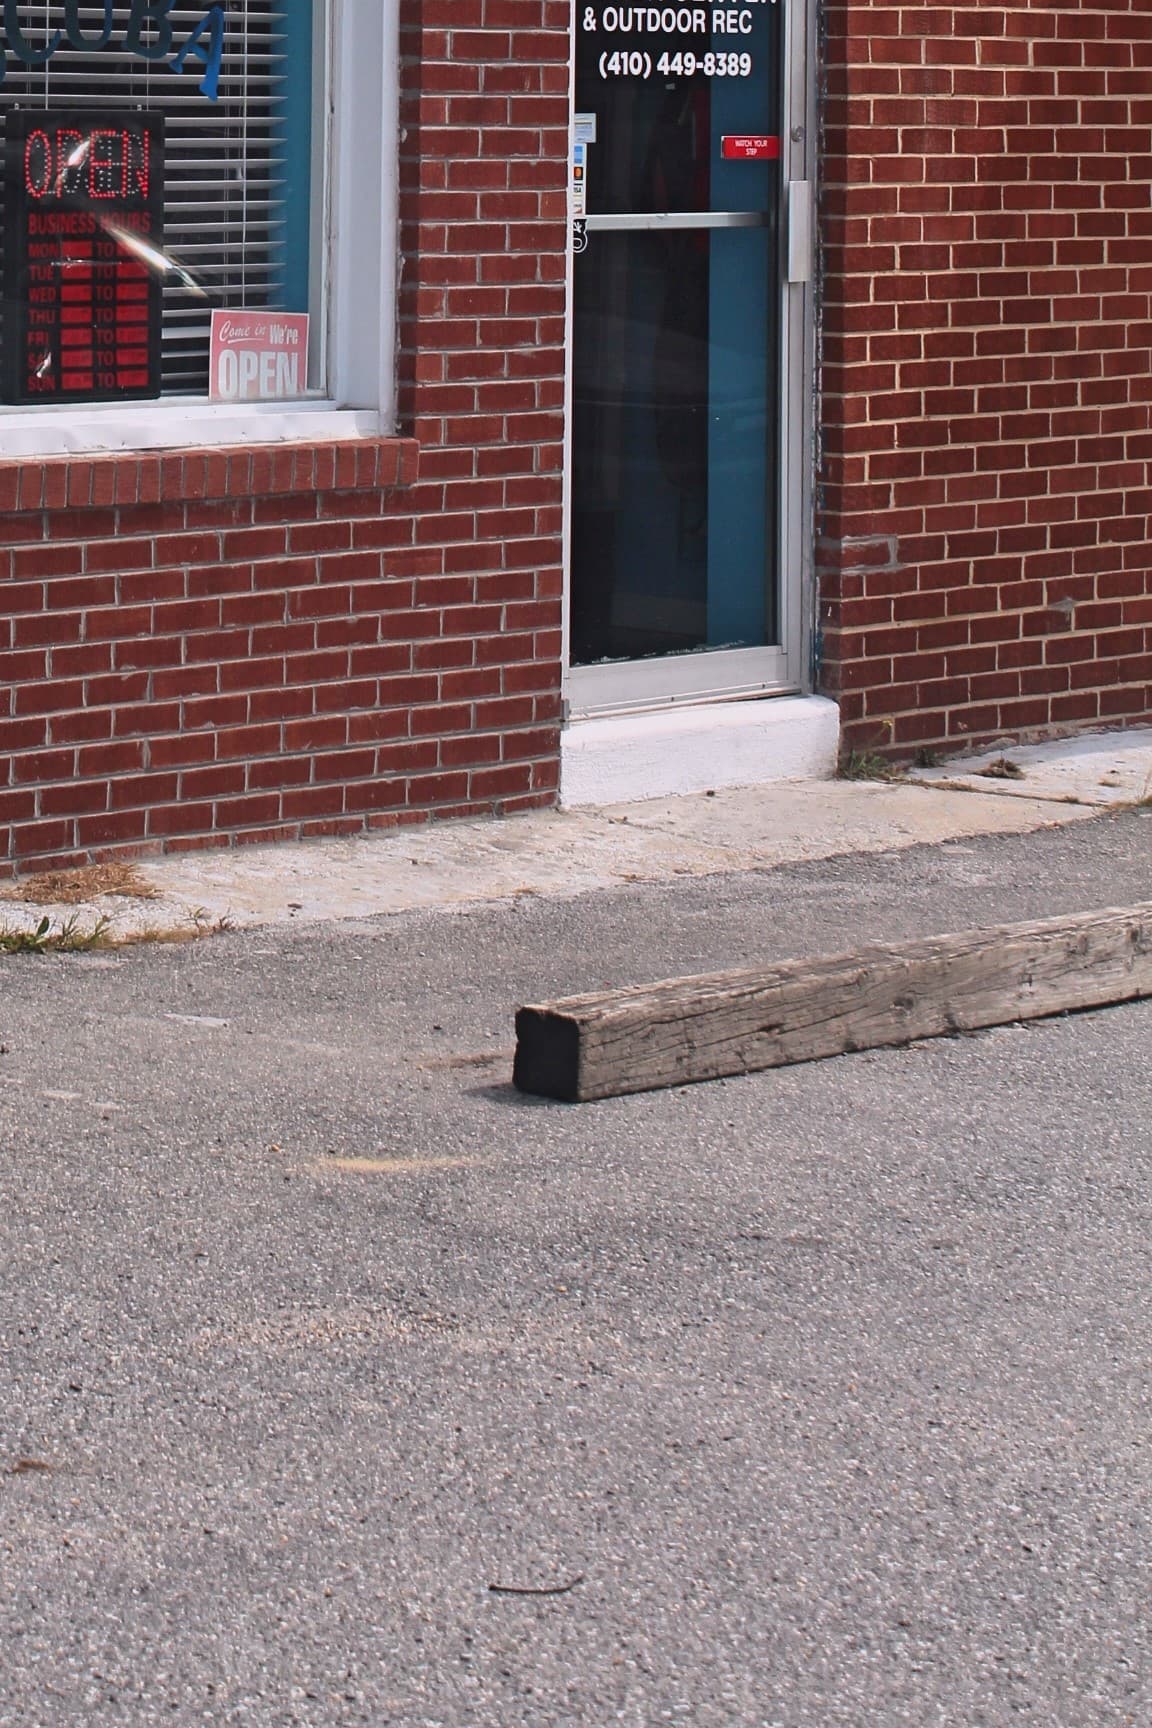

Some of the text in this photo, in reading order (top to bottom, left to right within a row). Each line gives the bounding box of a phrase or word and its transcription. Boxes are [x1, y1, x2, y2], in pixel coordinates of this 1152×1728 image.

[582, 6, 753, 34] & OUTDOOR REC
[598, 51, 753, 80] (410) 449-8389
[24, 128, 150, 200] OPEN
[28, 211, 96, 235] BUSINESS
[28, 287, 56, 303] WED
[28, 309, 56, 325] THU
[219, 320, 251, 342] Come
[218, 349, 298, 400] OPEN
